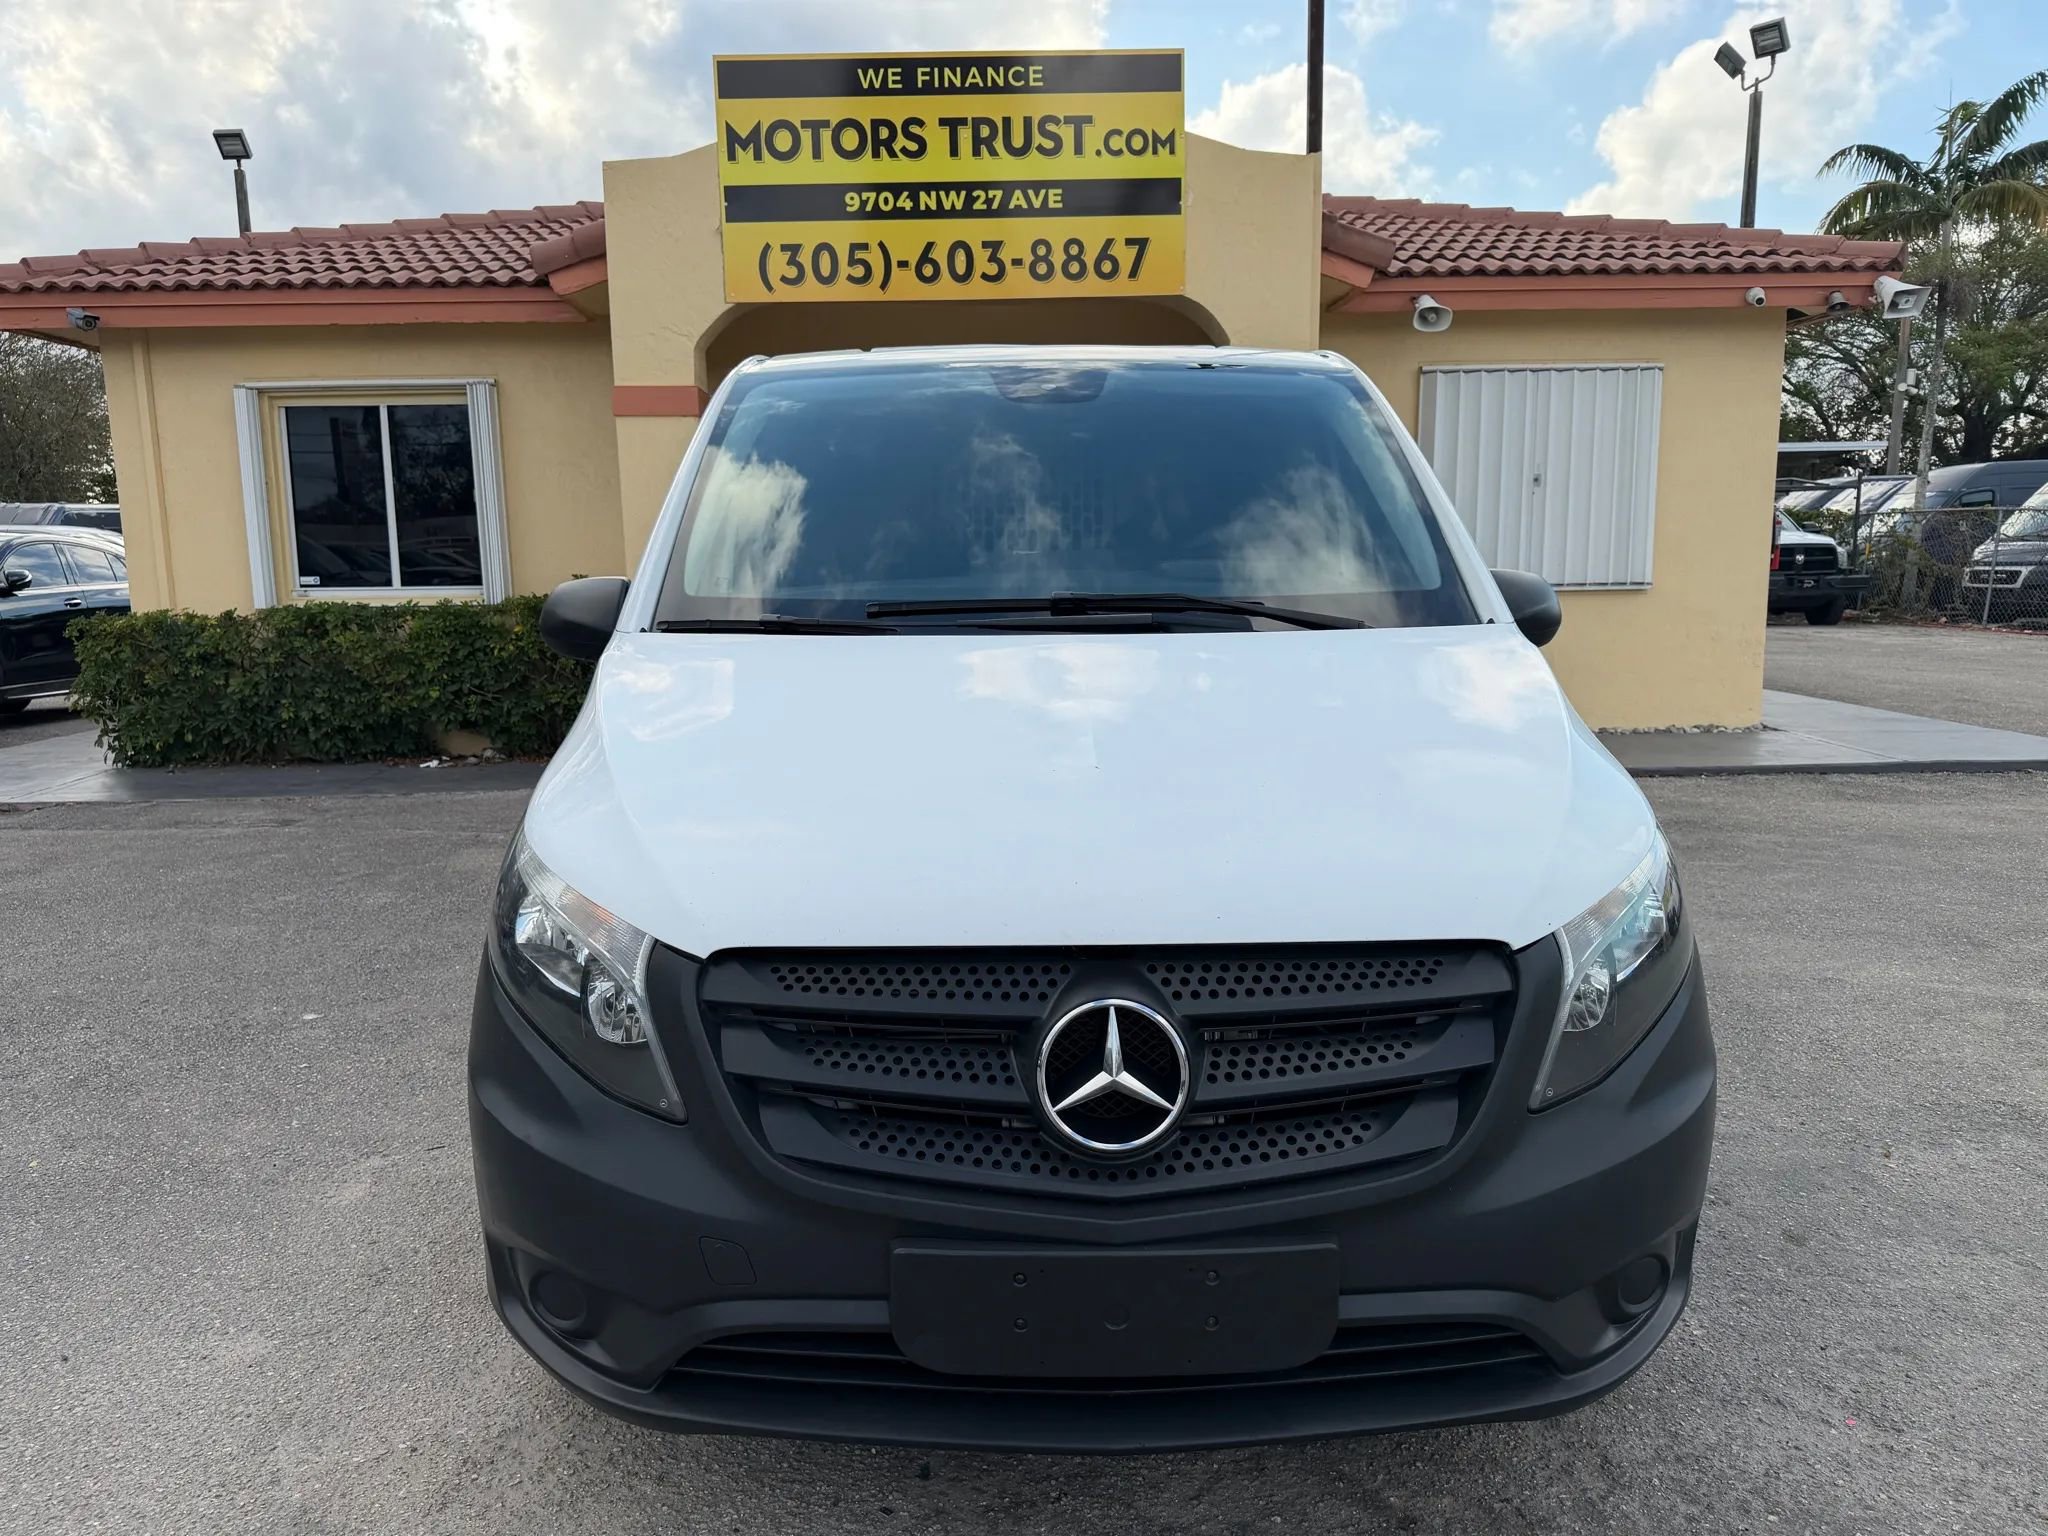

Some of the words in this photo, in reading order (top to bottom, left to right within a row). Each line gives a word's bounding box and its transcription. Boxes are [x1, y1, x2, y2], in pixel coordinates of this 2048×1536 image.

[857, 68, 903, 89] WE
[916, 66, 1044, 88] FINANCE
[726, 117, 928, 163] MOTORS
[938, 115, 1177, 160] TRUST.COM
[845, 191, 914, 212] 9704
[919, 191, 967, 210] NW
[972, 190, 1003, 210] 27
[1008, 189, 1063, 209] AVE
[757, 237, 1151, 294] (305)-603-8867
